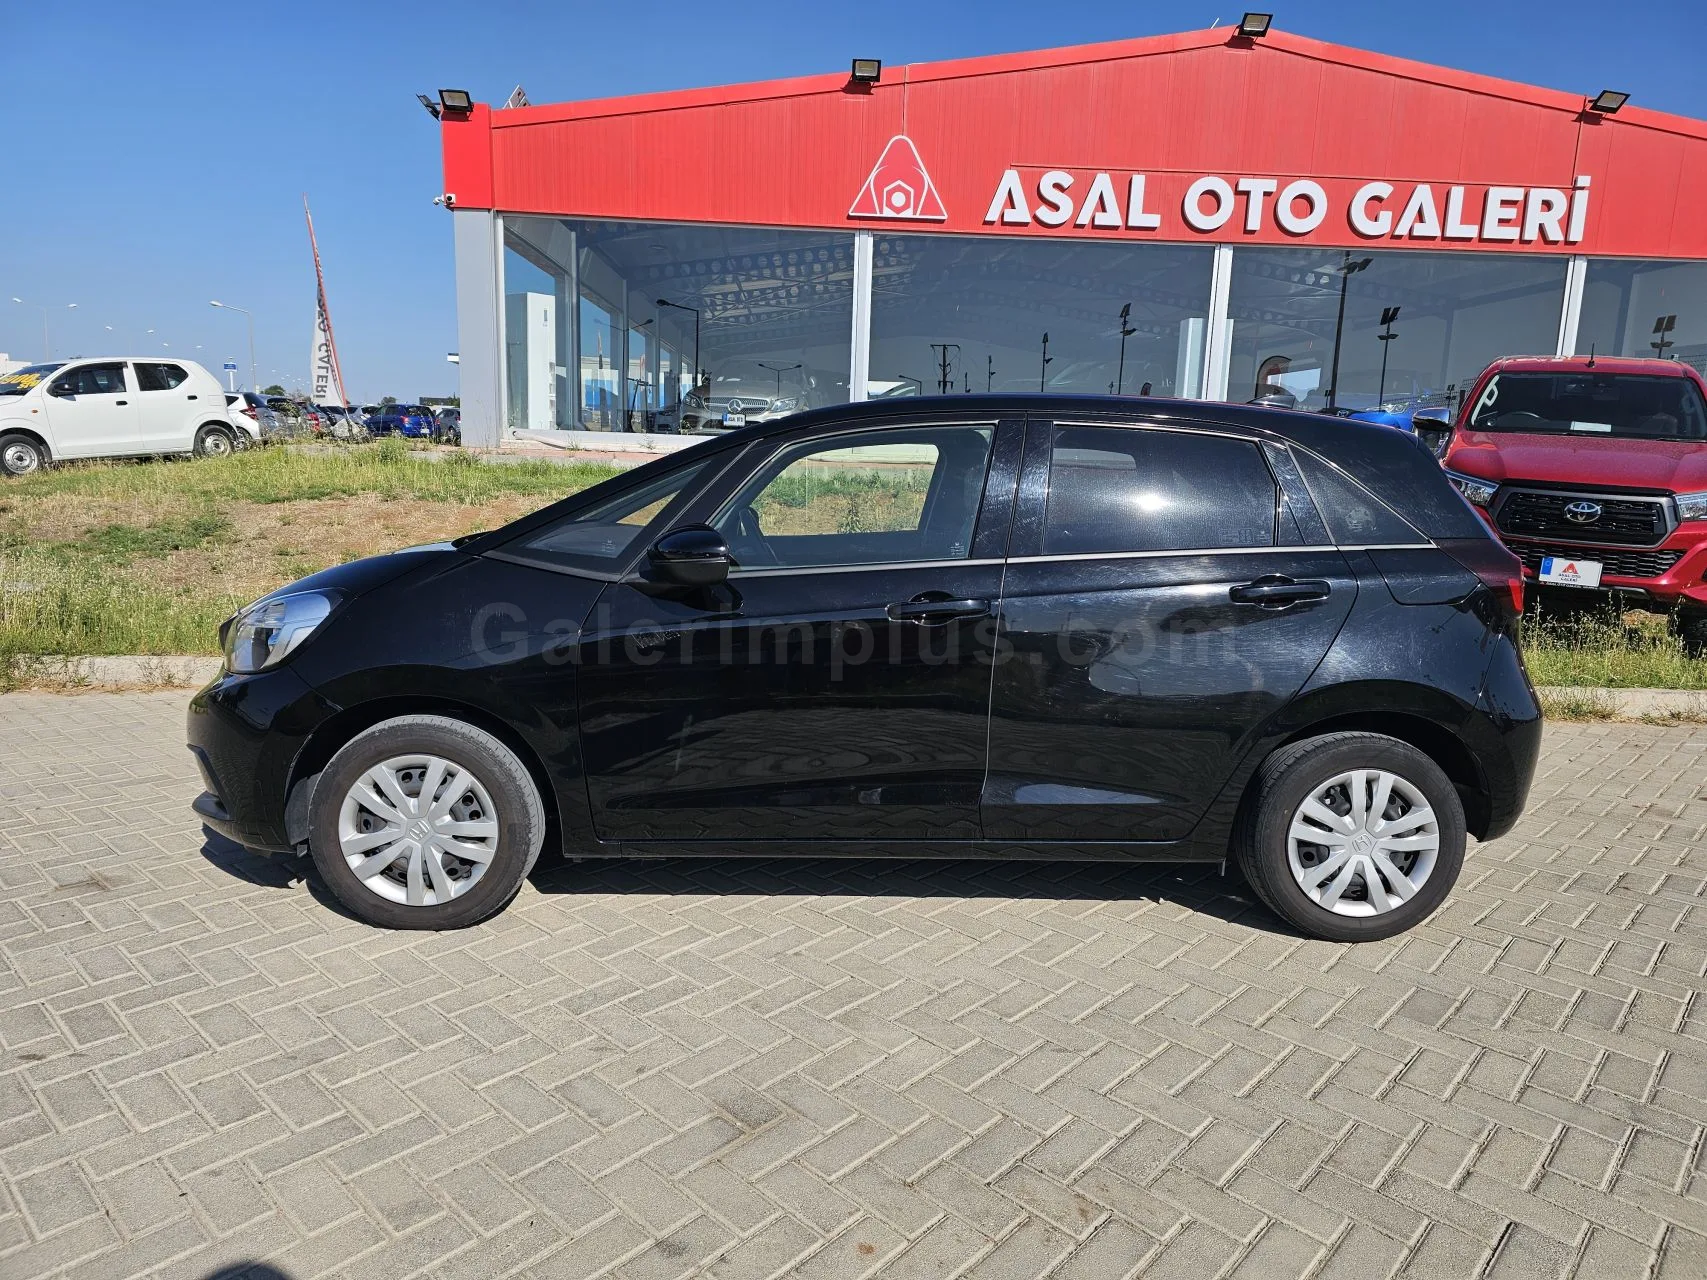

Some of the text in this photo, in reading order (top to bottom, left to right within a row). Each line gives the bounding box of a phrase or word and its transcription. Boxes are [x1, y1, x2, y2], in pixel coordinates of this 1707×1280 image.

[984, 169, 1592, 242] ASAL OTO GALERİ
